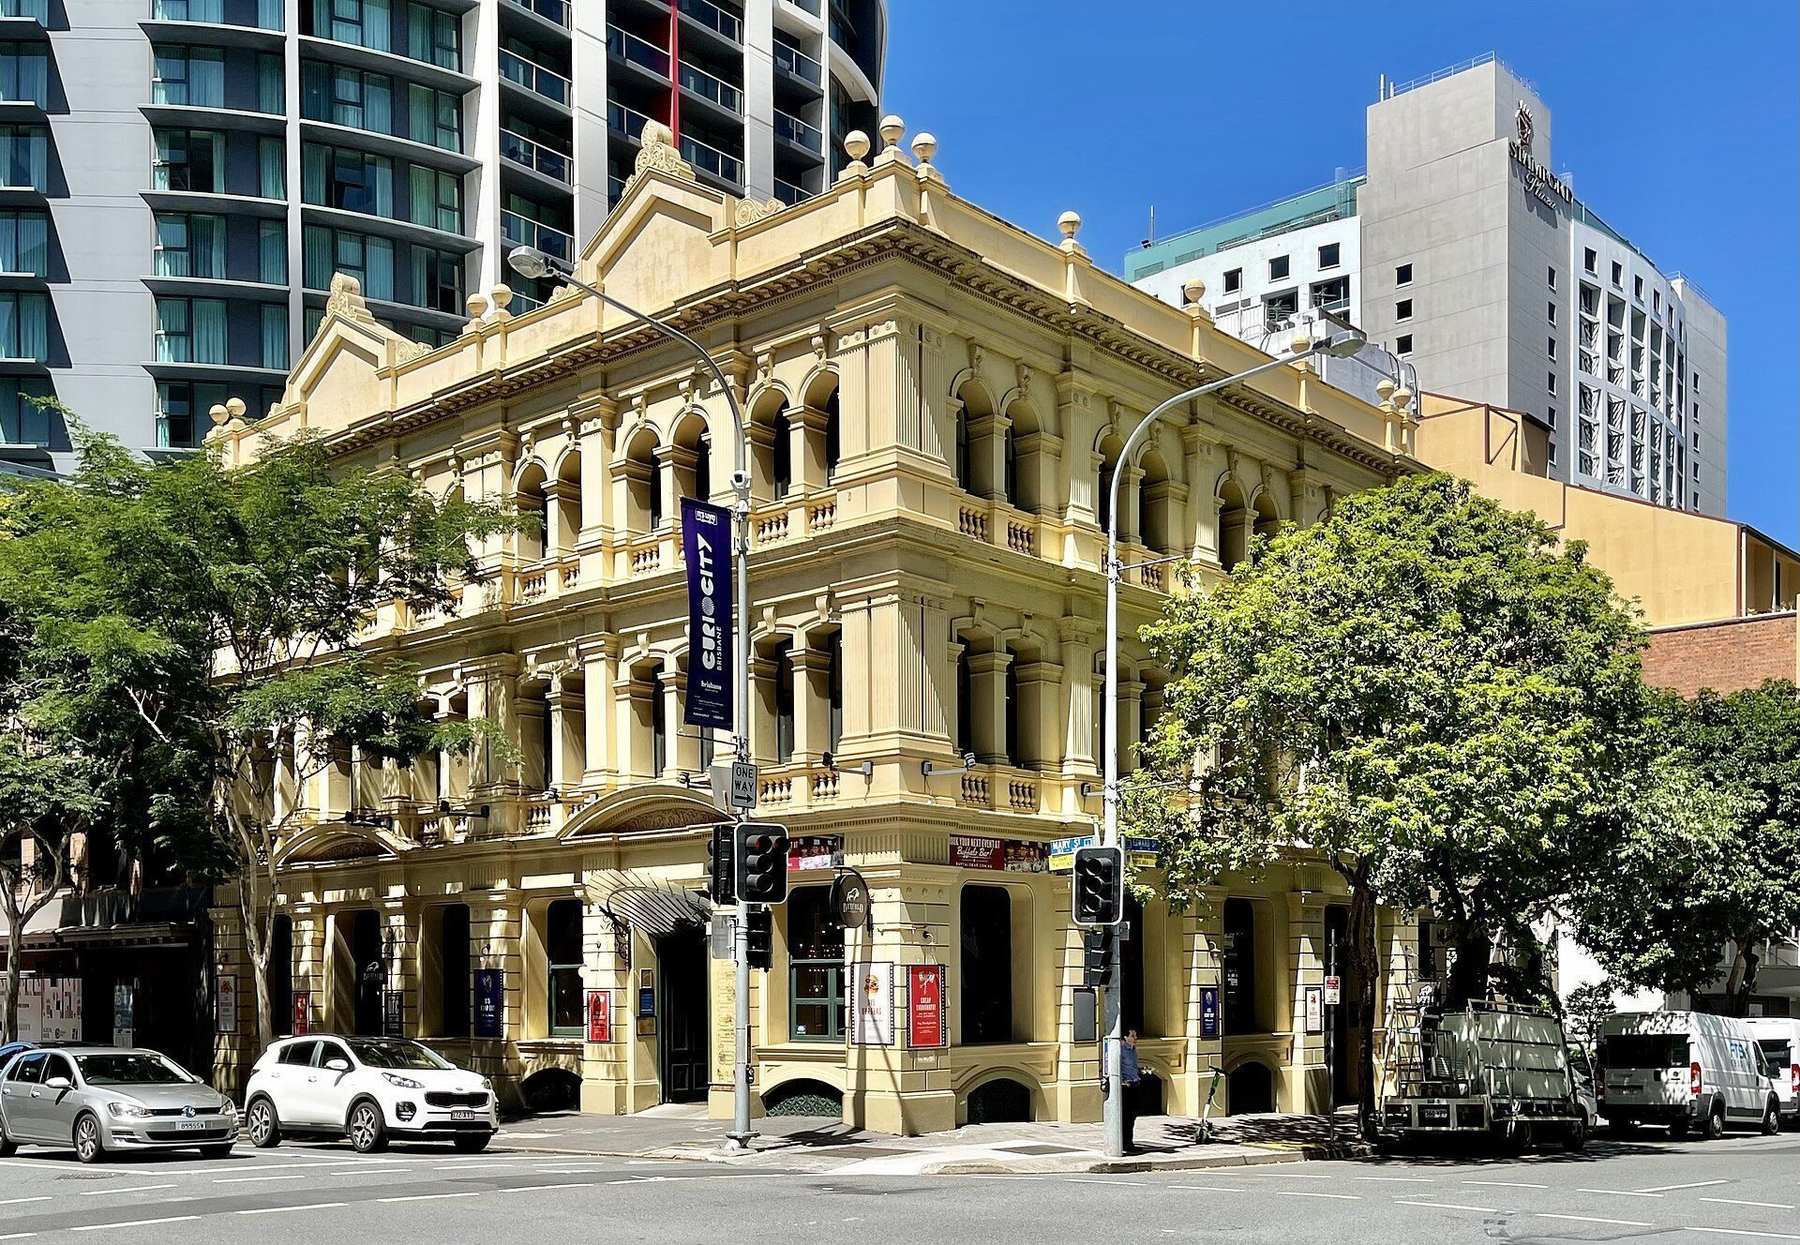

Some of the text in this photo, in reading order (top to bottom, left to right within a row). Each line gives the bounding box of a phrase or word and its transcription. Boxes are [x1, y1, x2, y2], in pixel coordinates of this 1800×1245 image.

[1525, 172, 1557, 209] Plaza
[696, 532, 716, 670] CURIOCITY
[736, 767, 754, 779] ONE
[735, 780, 754, 792] WAY
[956, 845, 979, 858] Buffalo
